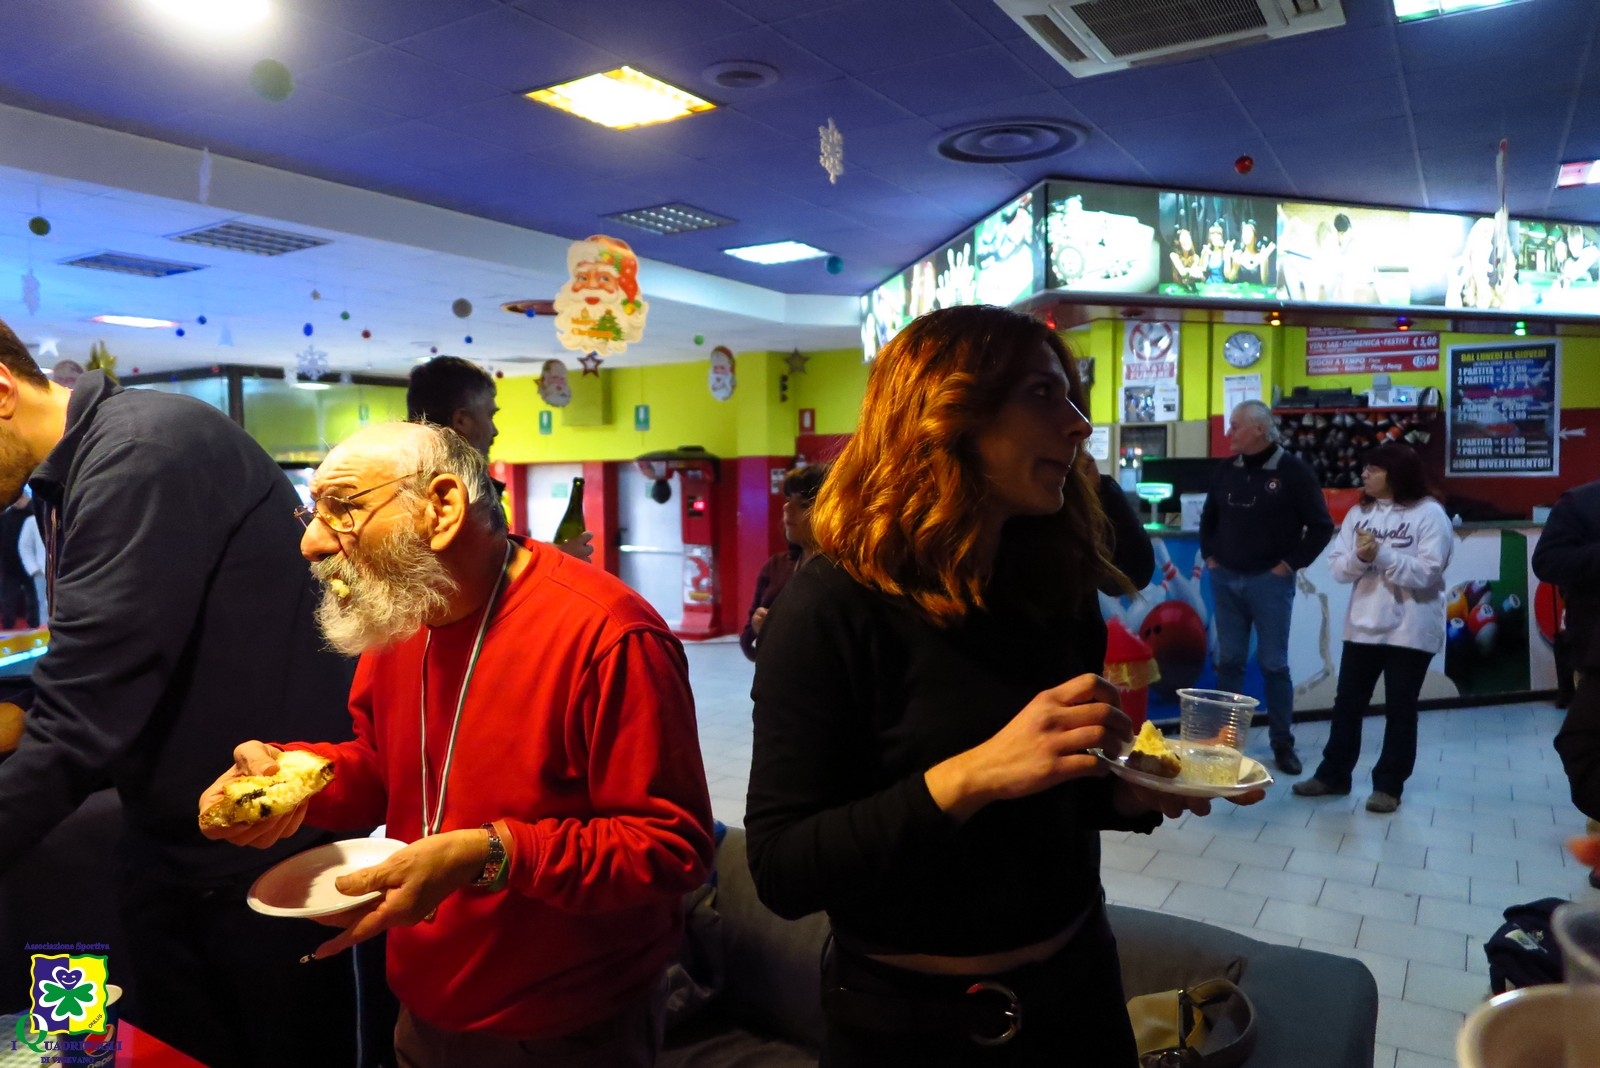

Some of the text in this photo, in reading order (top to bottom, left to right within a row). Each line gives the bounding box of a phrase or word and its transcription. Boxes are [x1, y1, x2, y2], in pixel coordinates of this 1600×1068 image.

[1342, 339, 1380, 348] DOMENICA
[1384, 337, 1409, 346] FESTIVI
[1463, 366, 1495, 376] PARTITA
[1463, 374, 1495, 385] PARTITE
[1462, 438, 1493, 447] PARTITA
[1462, 446, 1493, 455] PARTITE
[1478, 457, 1551, 469] DIVERTIMENTO!!
